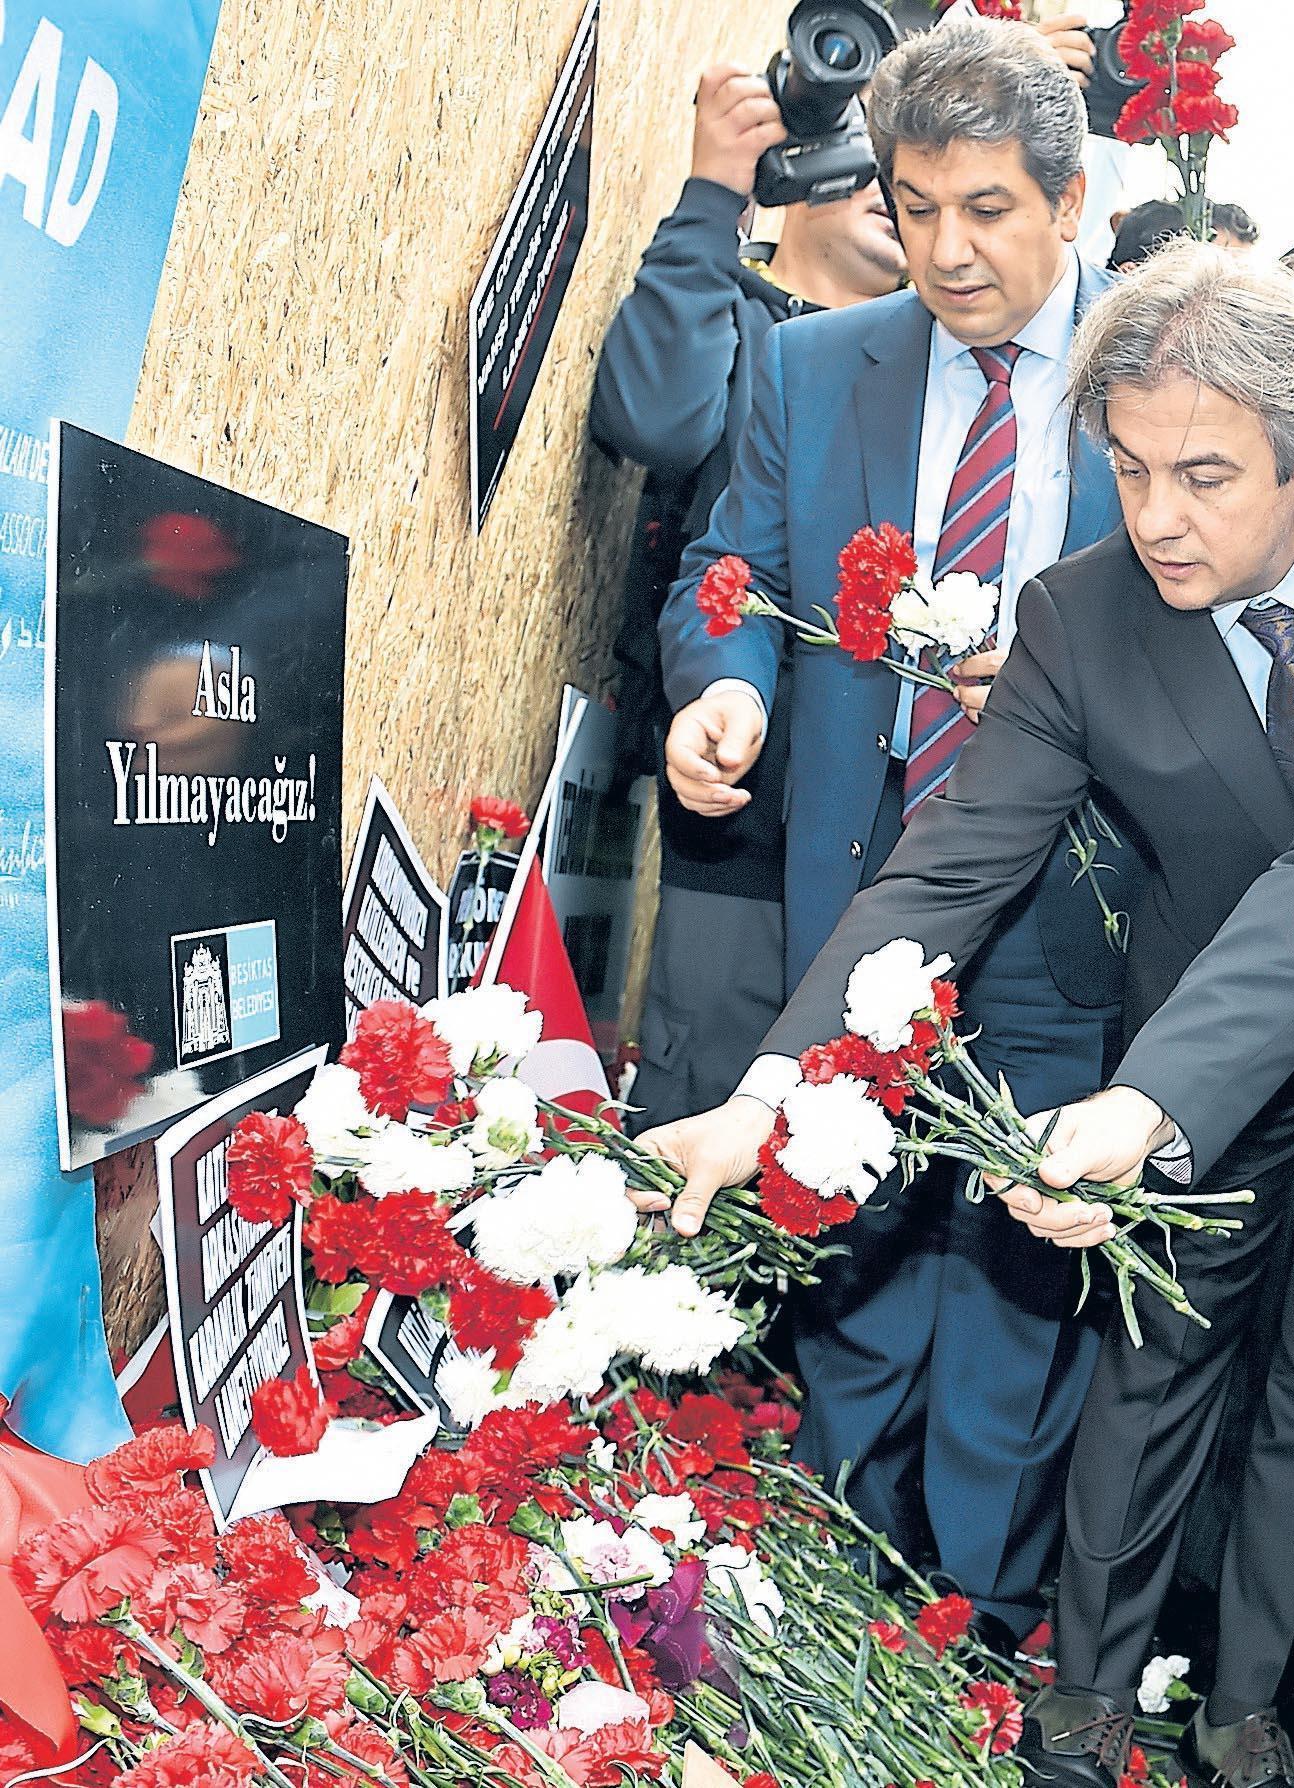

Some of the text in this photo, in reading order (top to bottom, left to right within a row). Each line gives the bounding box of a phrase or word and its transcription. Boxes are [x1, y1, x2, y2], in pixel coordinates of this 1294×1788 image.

[495, 158, 546, 292] CONDEMN
[191, 639, 257, 723] Asla
[105, 740, 317, 847] Yılmayacağız!
[188, 1281, 247, 1405] KARANLIK
